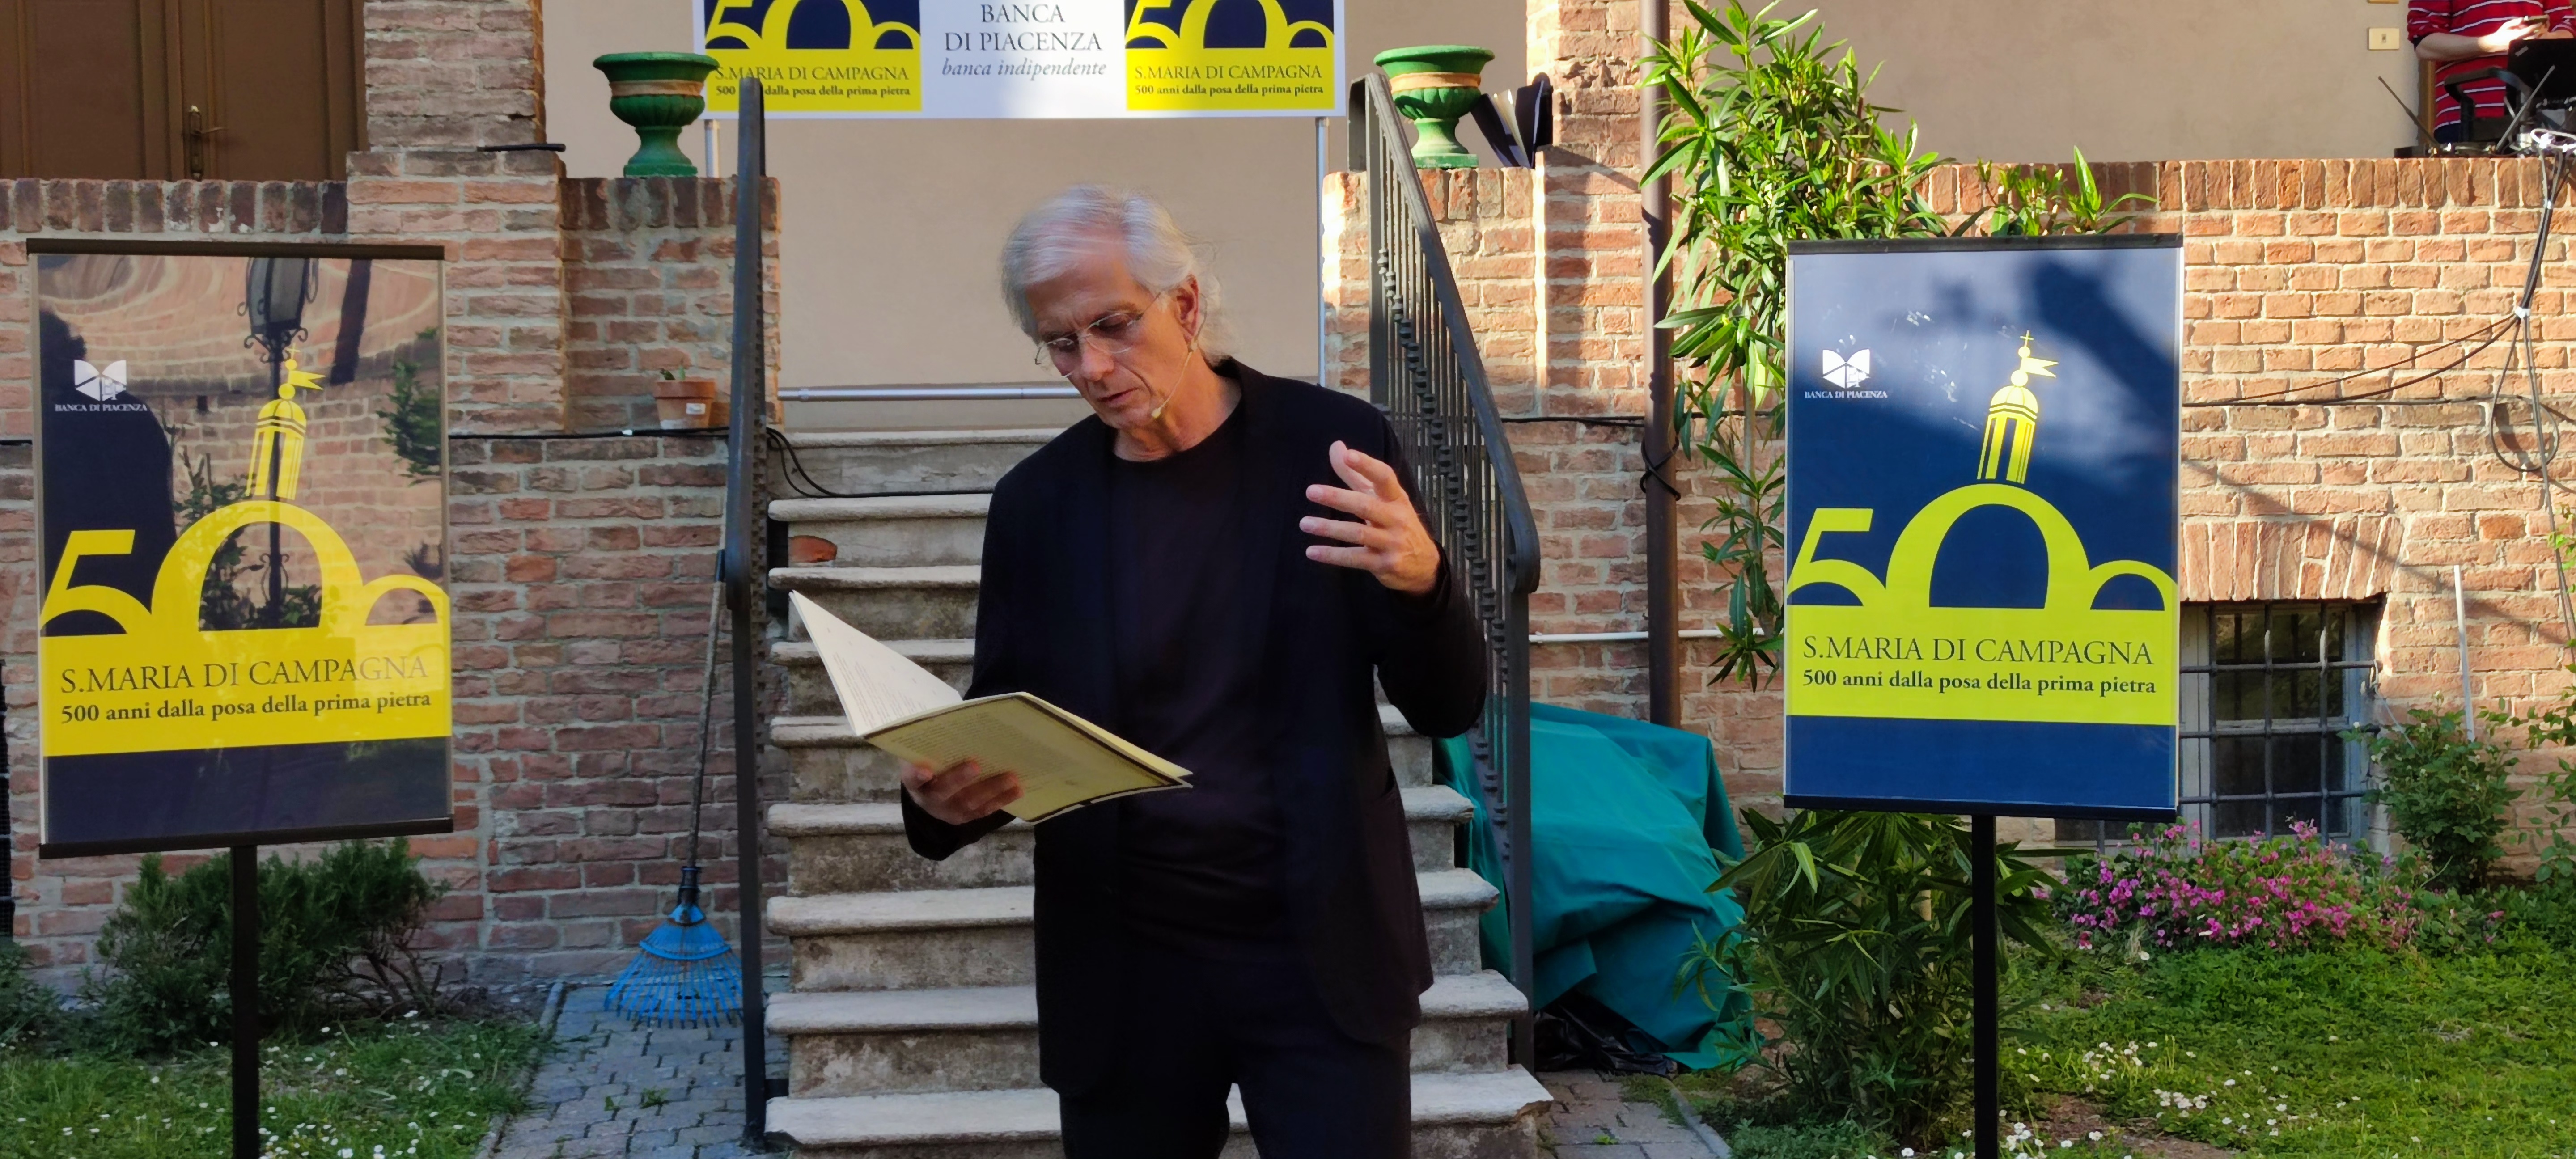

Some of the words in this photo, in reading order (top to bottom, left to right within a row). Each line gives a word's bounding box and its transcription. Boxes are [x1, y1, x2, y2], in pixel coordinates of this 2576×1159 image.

[981, 4, 1065, 23] BANCA
[945, 32, 971, 51] DI
[980, 32, 1103, 51] PIACENZA
[715, 66, 784, 80] S.MARIA
[788, 67, 807, 80] DI
[812, 66, 909, 80] CAMPAGNA
[942, 57, 991, 76] banca
[997, 57, 1107, 81] indipendente
[1135, 65, 1200, 79] S.MARIA
[1206, 65, 1223, 79] DI
[1228, 64, 1322, 79] CAMPAGNA
[716, 85, 736, 95] 500
[765, 85, 790, 95] dalla
[793, 88, 816, 98] posa
[819, 85, 843, 95] della
[847, 86, 877, 97] prima
[880, 86, 910, 98] pietra
[1135, 85, 1154, 95] 500
[1157, 85, 1179, 94] anni
[1182, 85, 1207, 94] dalla
[1210, 87, 1232, 97] posa
[1235, 84, 1258, 94] della
[1262, 85, 1291, 96] prima
[1294, 85, 1323, 97] pietra
[1847, 390, 1888, 398] PIACENZA
[55, 404, 87, 412] BANCA
[1803, 636, 1924, 660] S.MARIA
[1933, 639, 1965, 661] DI
[1976, 639, 2154, 665] CAMPAGNA
[61, 664, 192, 693] S.MARIA
[203, 663, 238, 687] DI
[249, 656, 428, 685] CAMPAGNA
[1803, 670, 1837, 686] 500
[1843, 671, 1883, 687] anni
[1889, 670, 1933, 688] dalla
[1939, 676, 1981, 694] posa
[1987, 673, 2032, 690] della
[2038, 675, 2094, 696] prima
[2101, 677, 2156, 697] pietra
[61, 704, 99, 724] 500
[106, 702, 150, 721] anni
[157, 698, 204, 718] dalla
[212, 701, 255, 721] posa
[263, 694, 308, 714] della
[314, 695, 370, 716] prima
[377, 692, 431, 713] pietra
